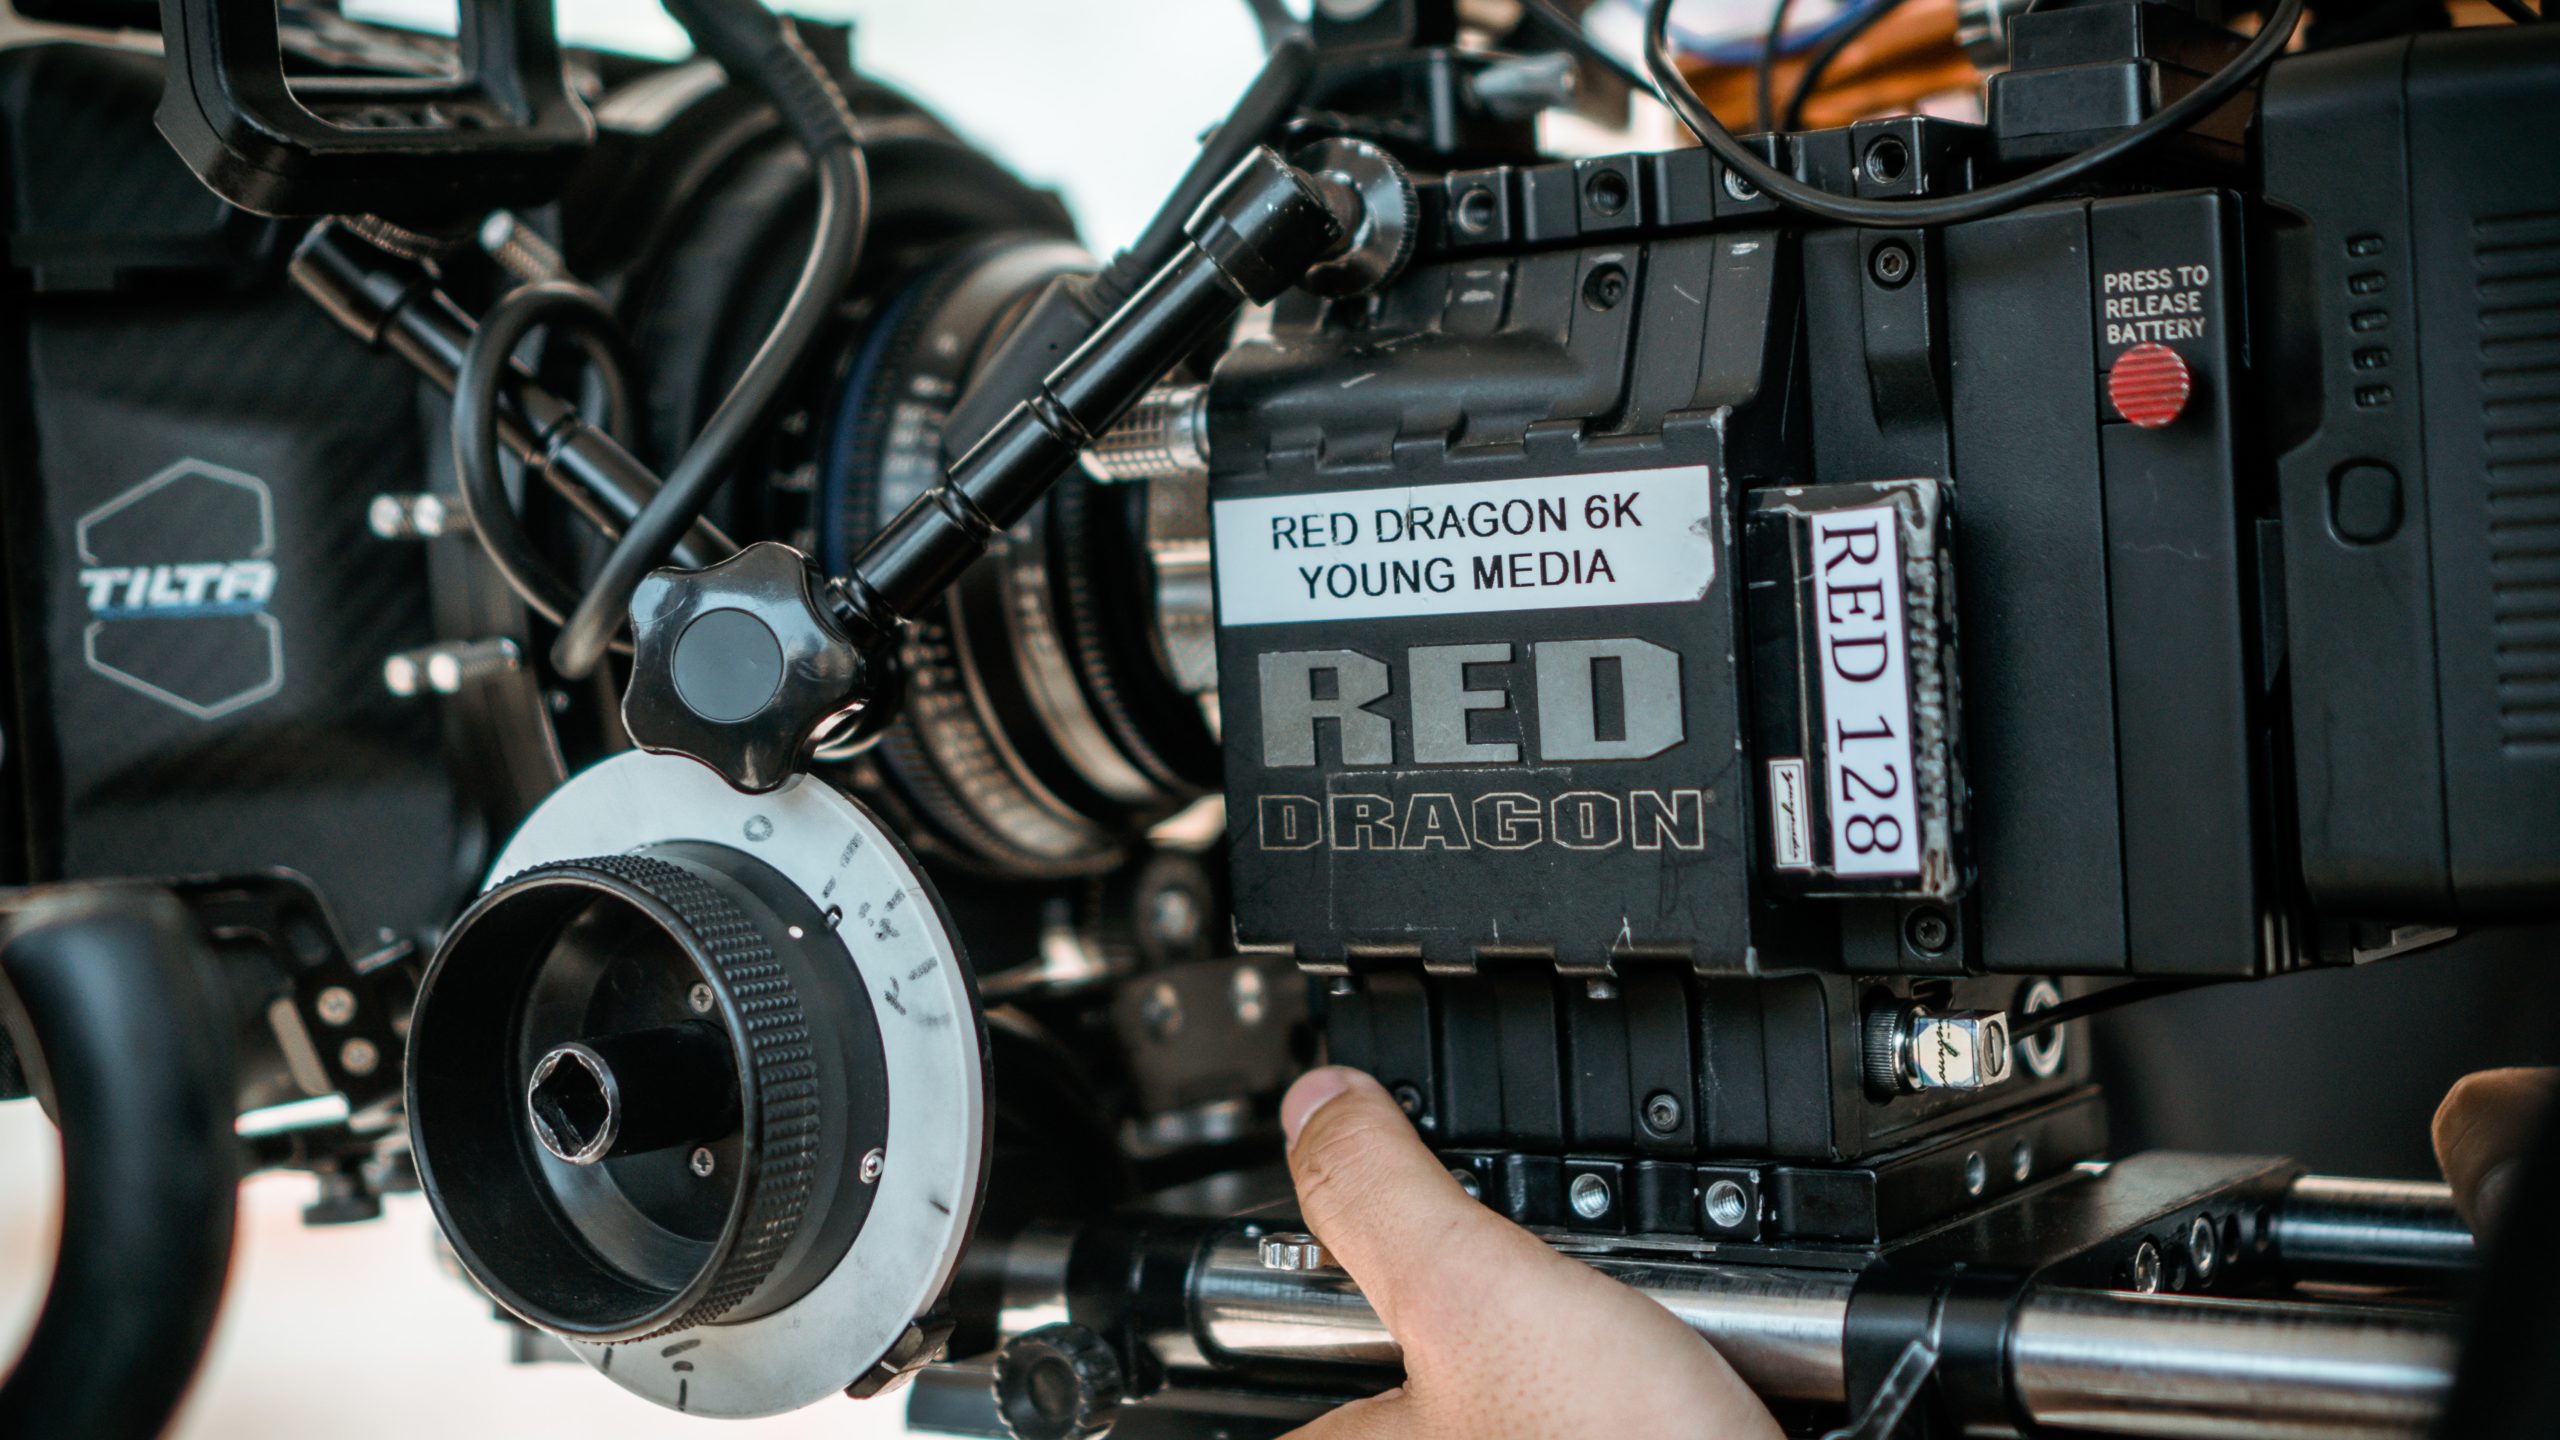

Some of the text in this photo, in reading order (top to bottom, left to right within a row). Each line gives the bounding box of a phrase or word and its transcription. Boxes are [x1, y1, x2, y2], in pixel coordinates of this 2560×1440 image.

[2104, 265, 2209, 293] PRESS TO
[2105, 291, 2202, 319] RELEASE
[2106, 317, 2206, 344] BATTERY
[1272, 492, 1643, 550] RED DRAGON 6K
[79, 559, 278, 611] TILTA
[1299, 549, 1616, 599] YOUNG MEDIA
[1258, 638, 1687, 767] RED
[1822, 521, 1902, 855] RED 128
[1258, 790, 1704, 850] DRAGON
